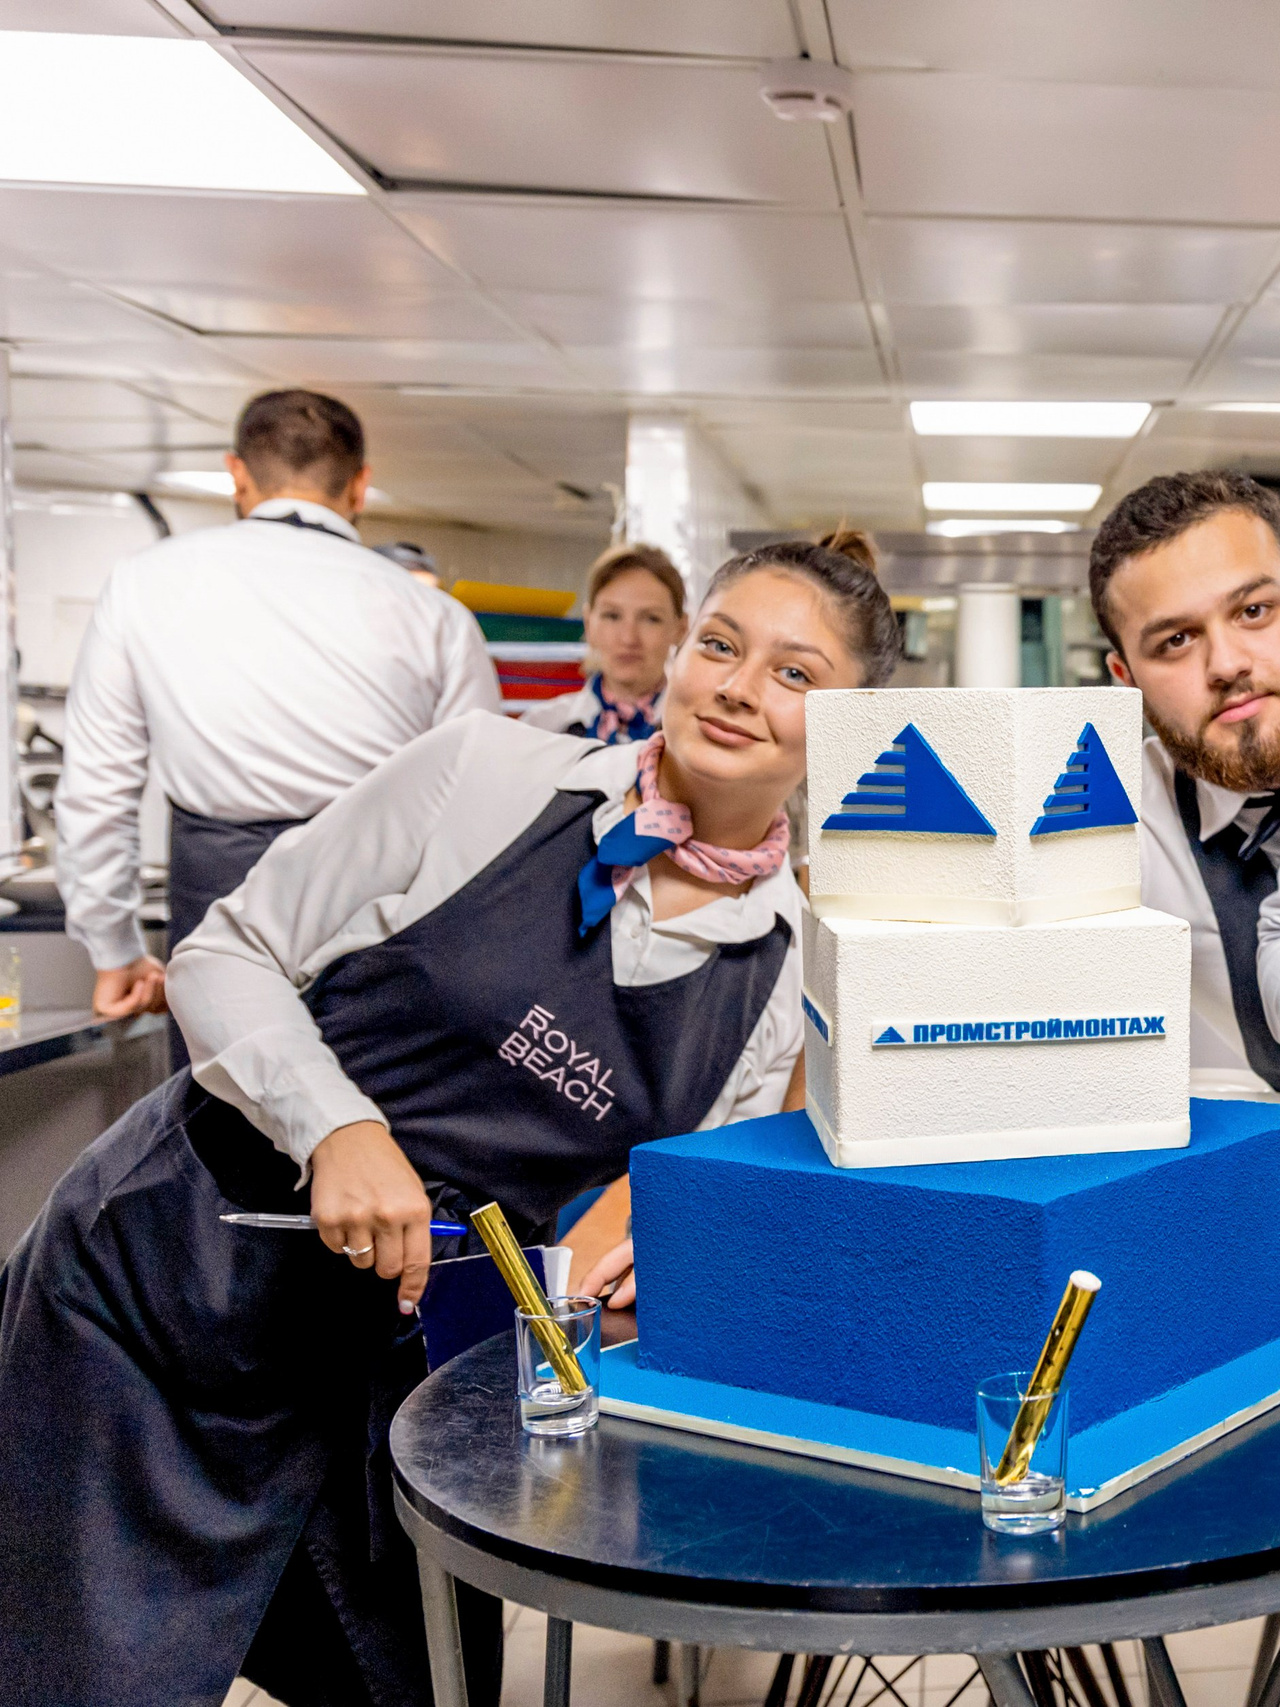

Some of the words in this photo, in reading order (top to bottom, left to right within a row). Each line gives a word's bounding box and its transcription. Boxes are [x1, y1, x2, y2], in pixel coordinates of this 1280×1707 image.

[519, 1004, 616, 1097] ROYAL
[913, 1016, 1166, 1043] ПРОМСТРОЙМОНТАЖ
[500, 1031, 613, 1121] BEACH
